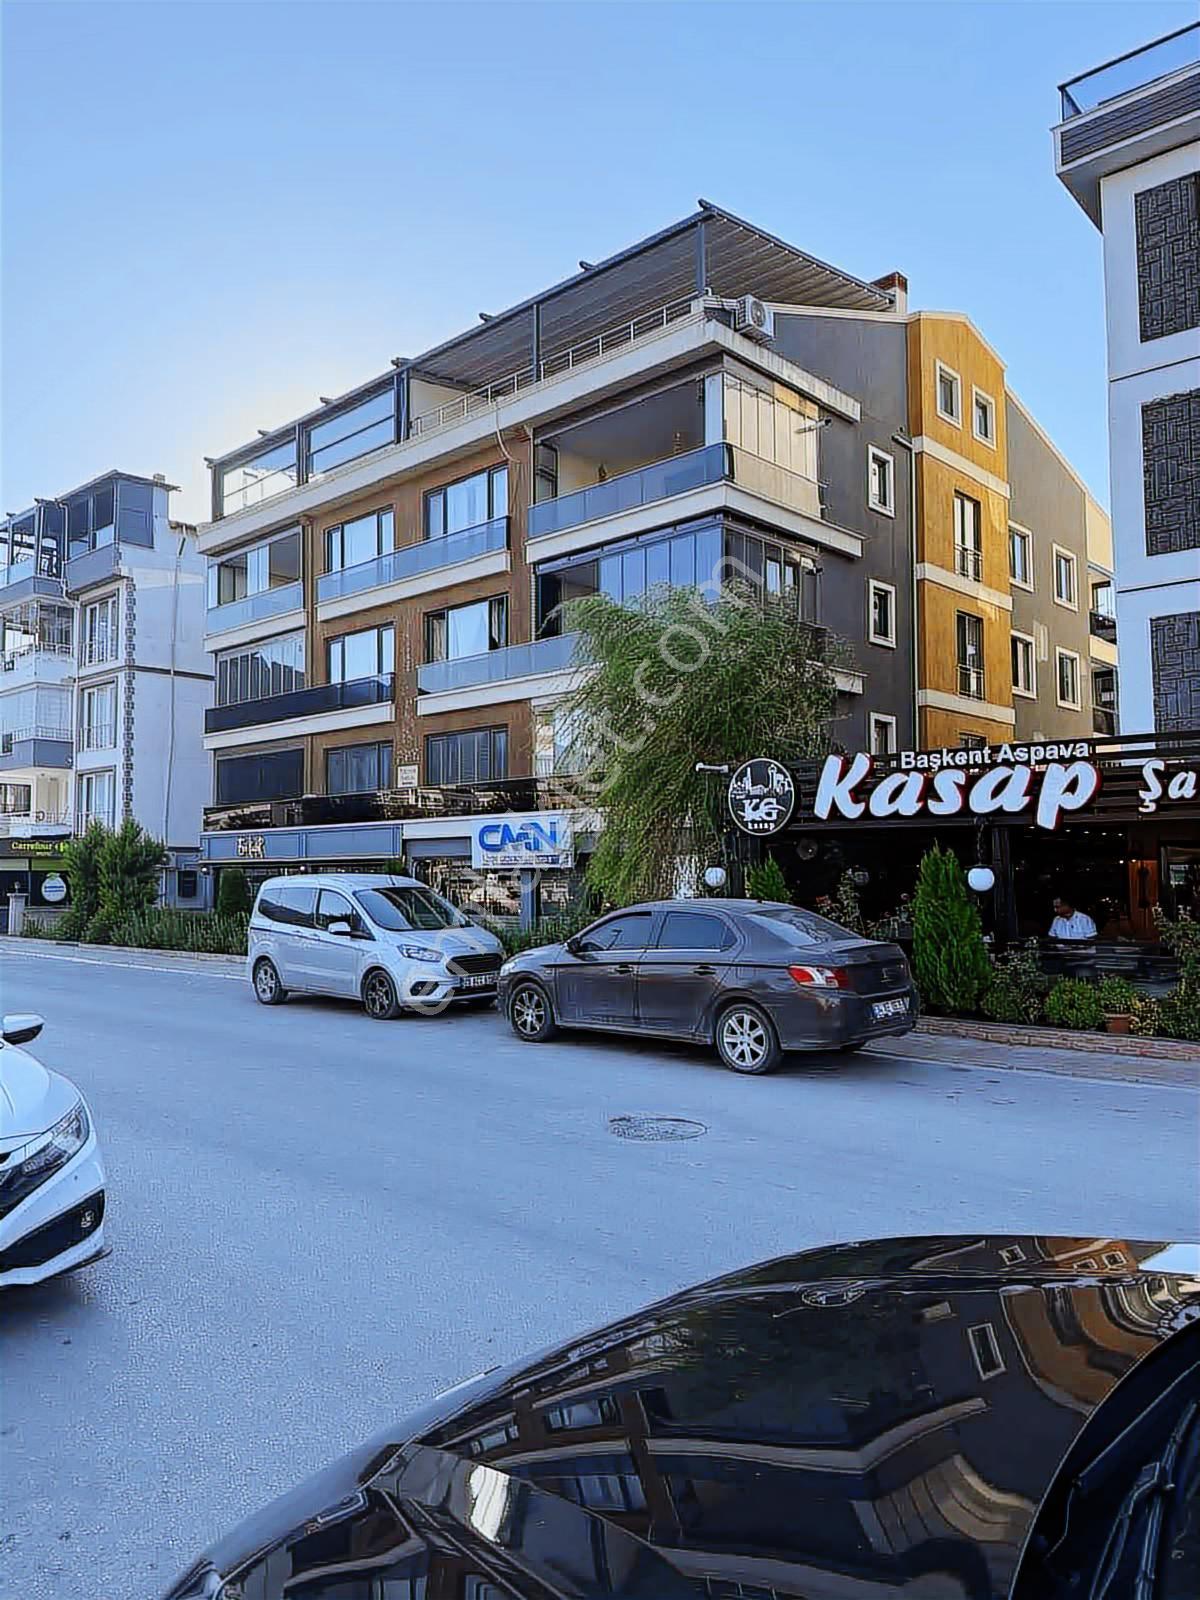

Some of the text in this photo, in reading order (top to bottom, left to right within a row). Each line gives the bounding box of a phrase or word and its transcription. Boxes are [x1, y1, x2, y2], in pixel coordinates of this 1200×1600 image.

[900, 741, 1090, 771] Başkent Aspava
[813, 752, 1101, 830] Kasap
